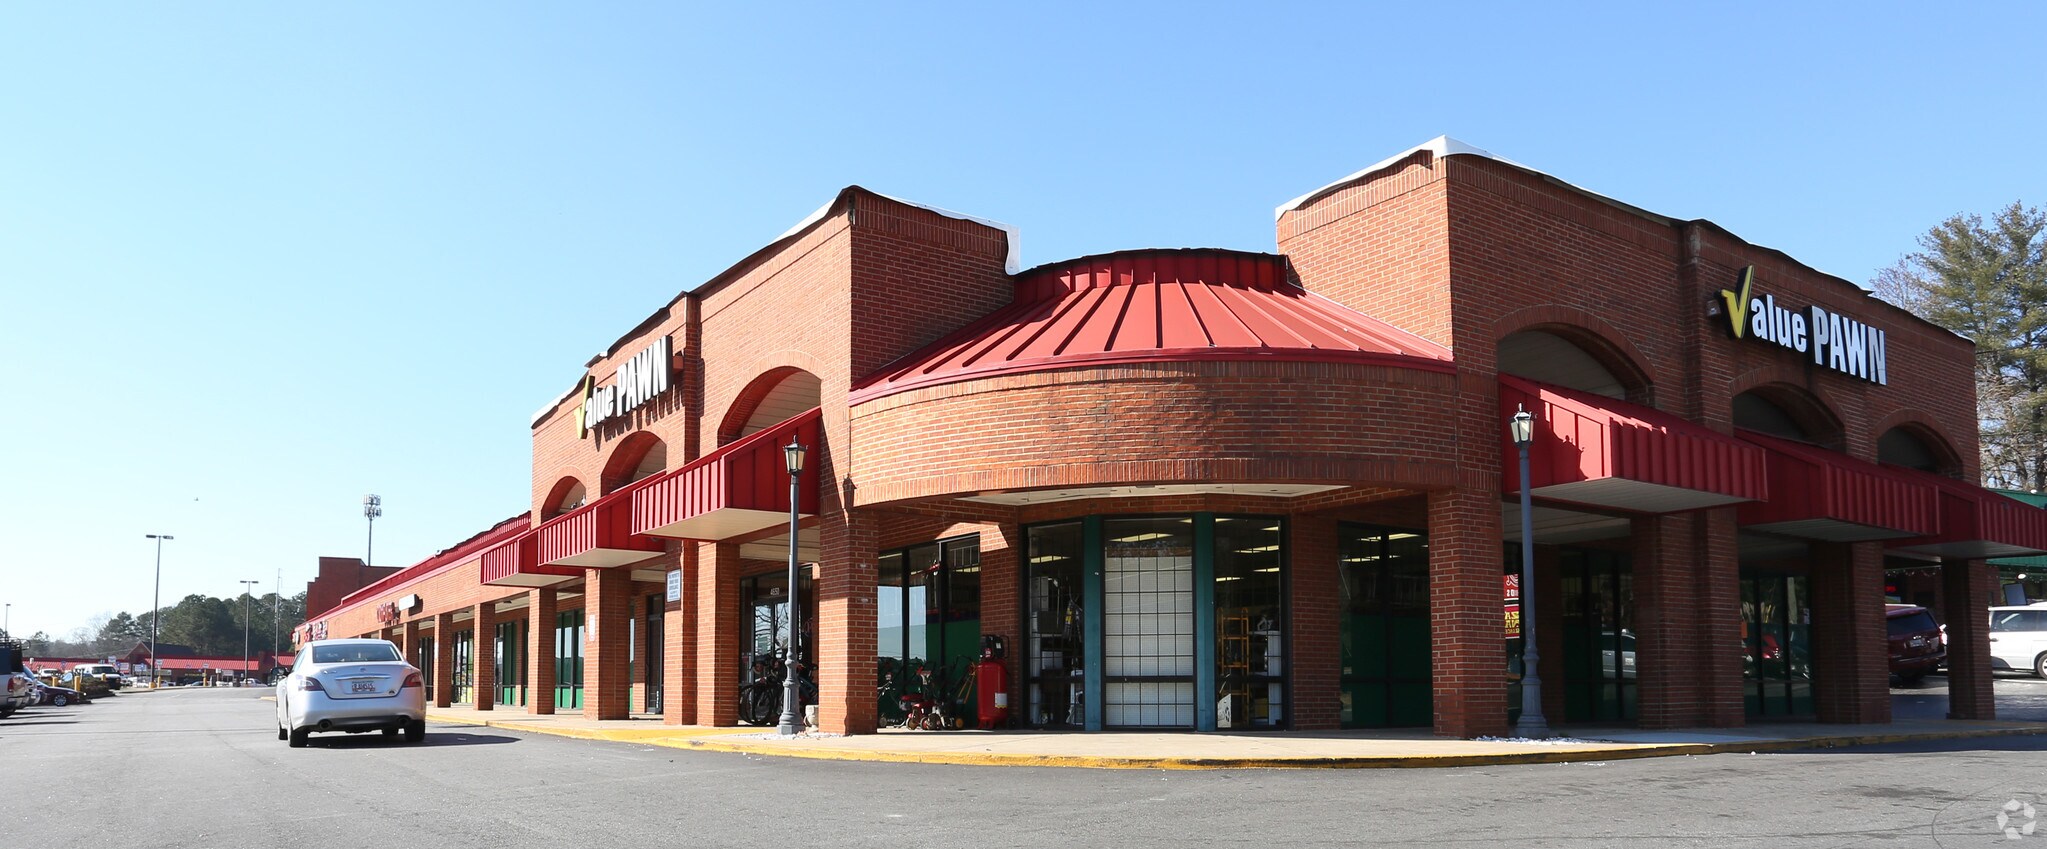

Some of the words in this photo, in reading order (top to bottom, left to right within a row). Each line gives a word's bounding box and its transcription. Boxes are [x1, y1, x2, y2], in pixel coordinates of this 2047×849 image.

[1720, 264, 1808, 353] Value
[1811, 305, 1887, 386] PAWN
[573, 375, 614, 440] Value
[616, 335, 669, 418] PAWN
